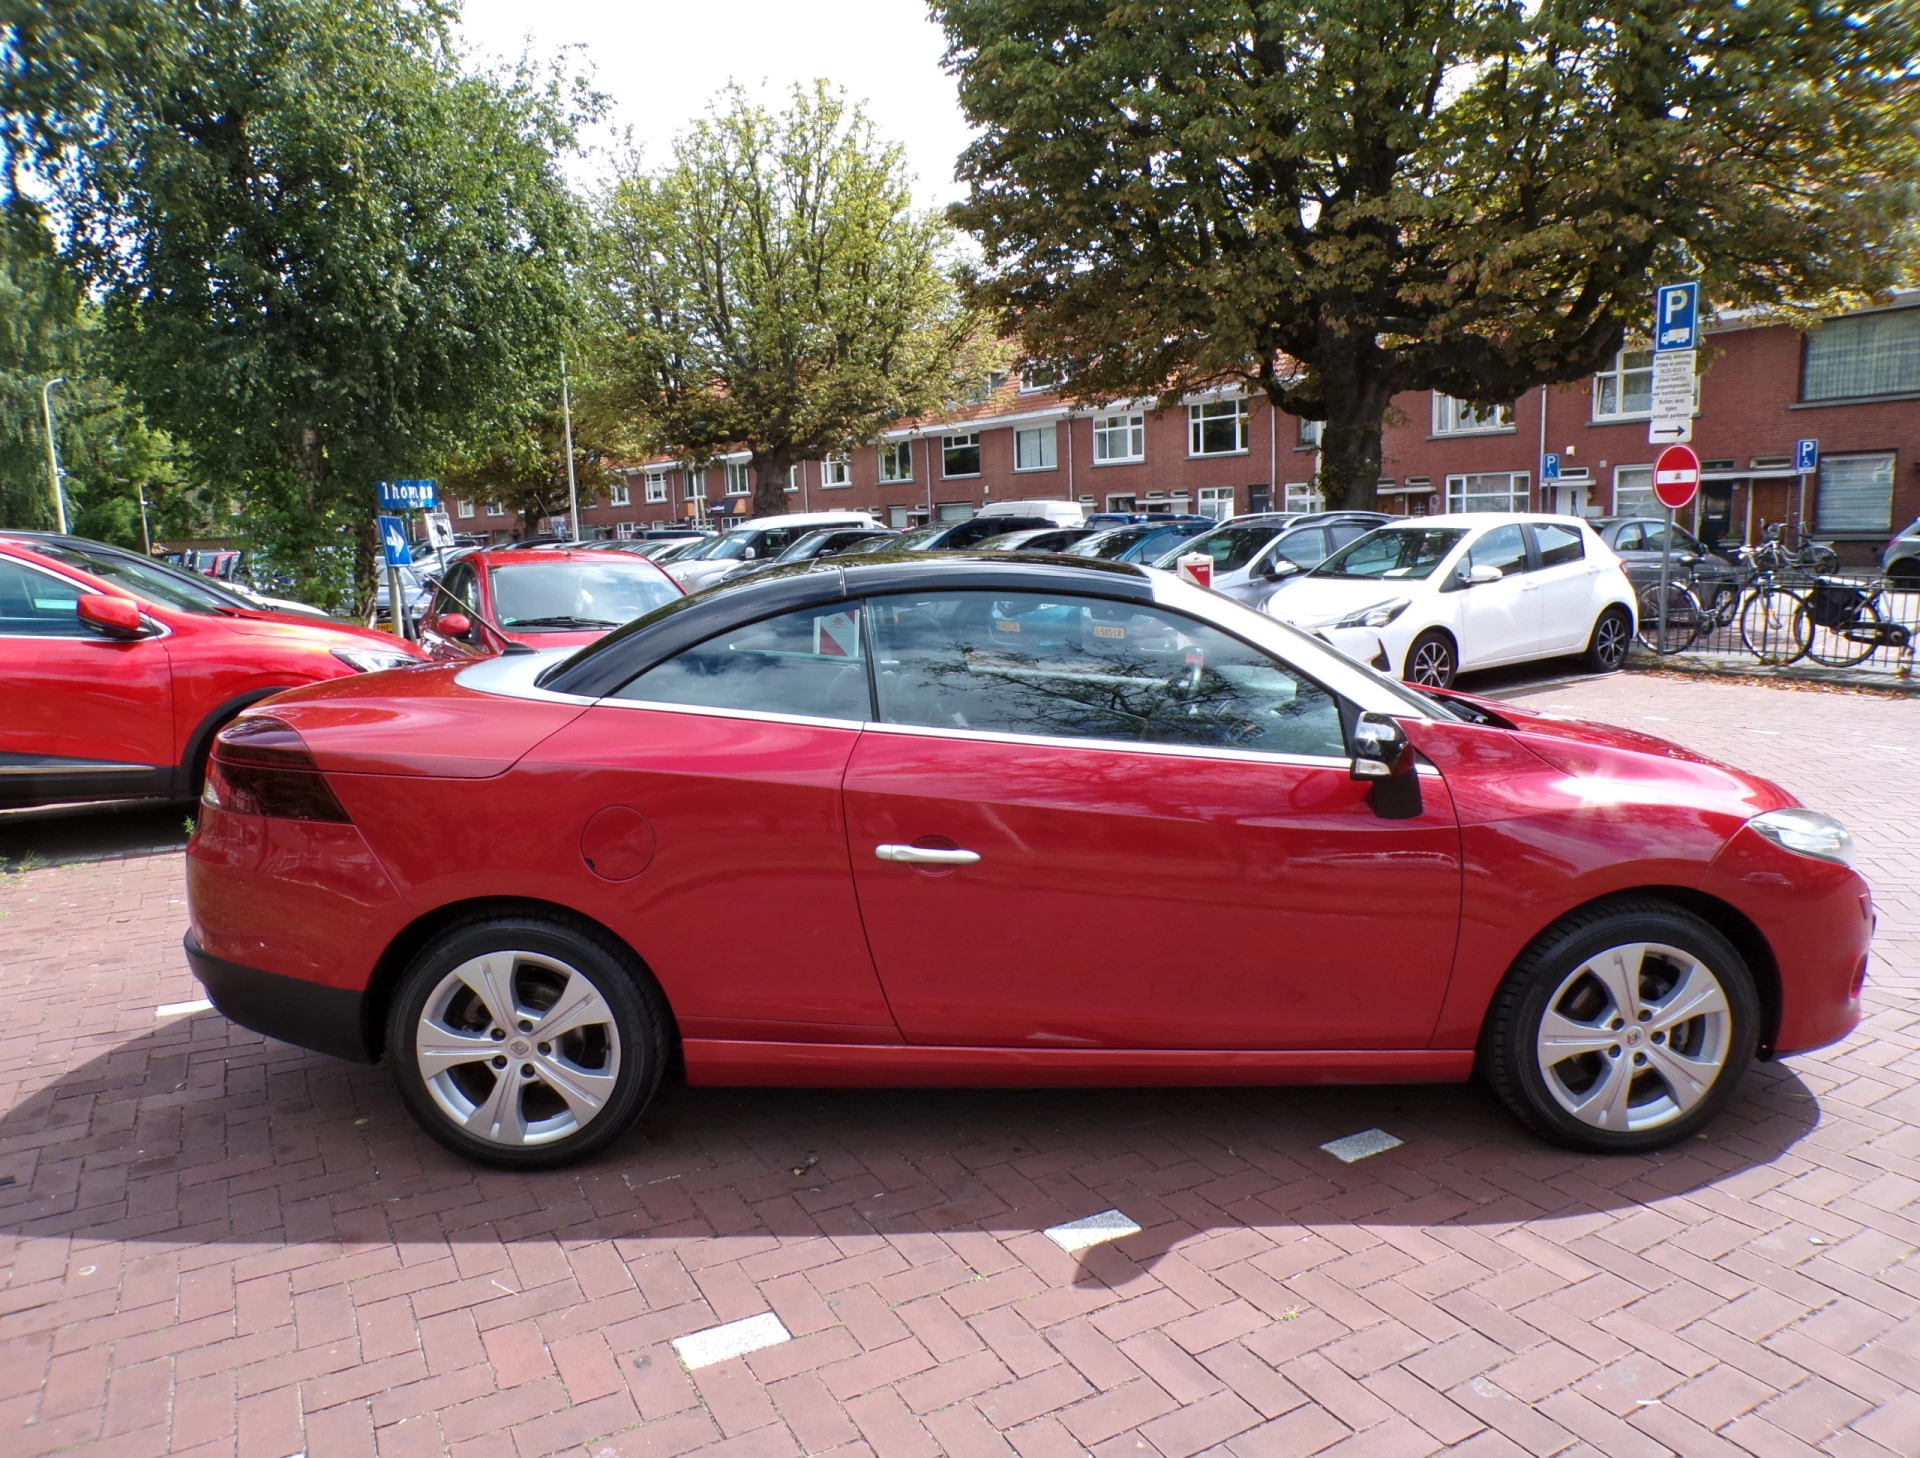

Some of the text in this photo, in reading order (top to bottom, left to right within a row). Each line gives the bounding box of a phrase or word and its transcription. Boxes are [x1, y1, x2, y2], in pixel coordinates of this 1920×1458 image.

[1665, 290, 1687, 324] P
[1802, 441, 1814, 457] P
[1547, 455, 1556, 468] P
